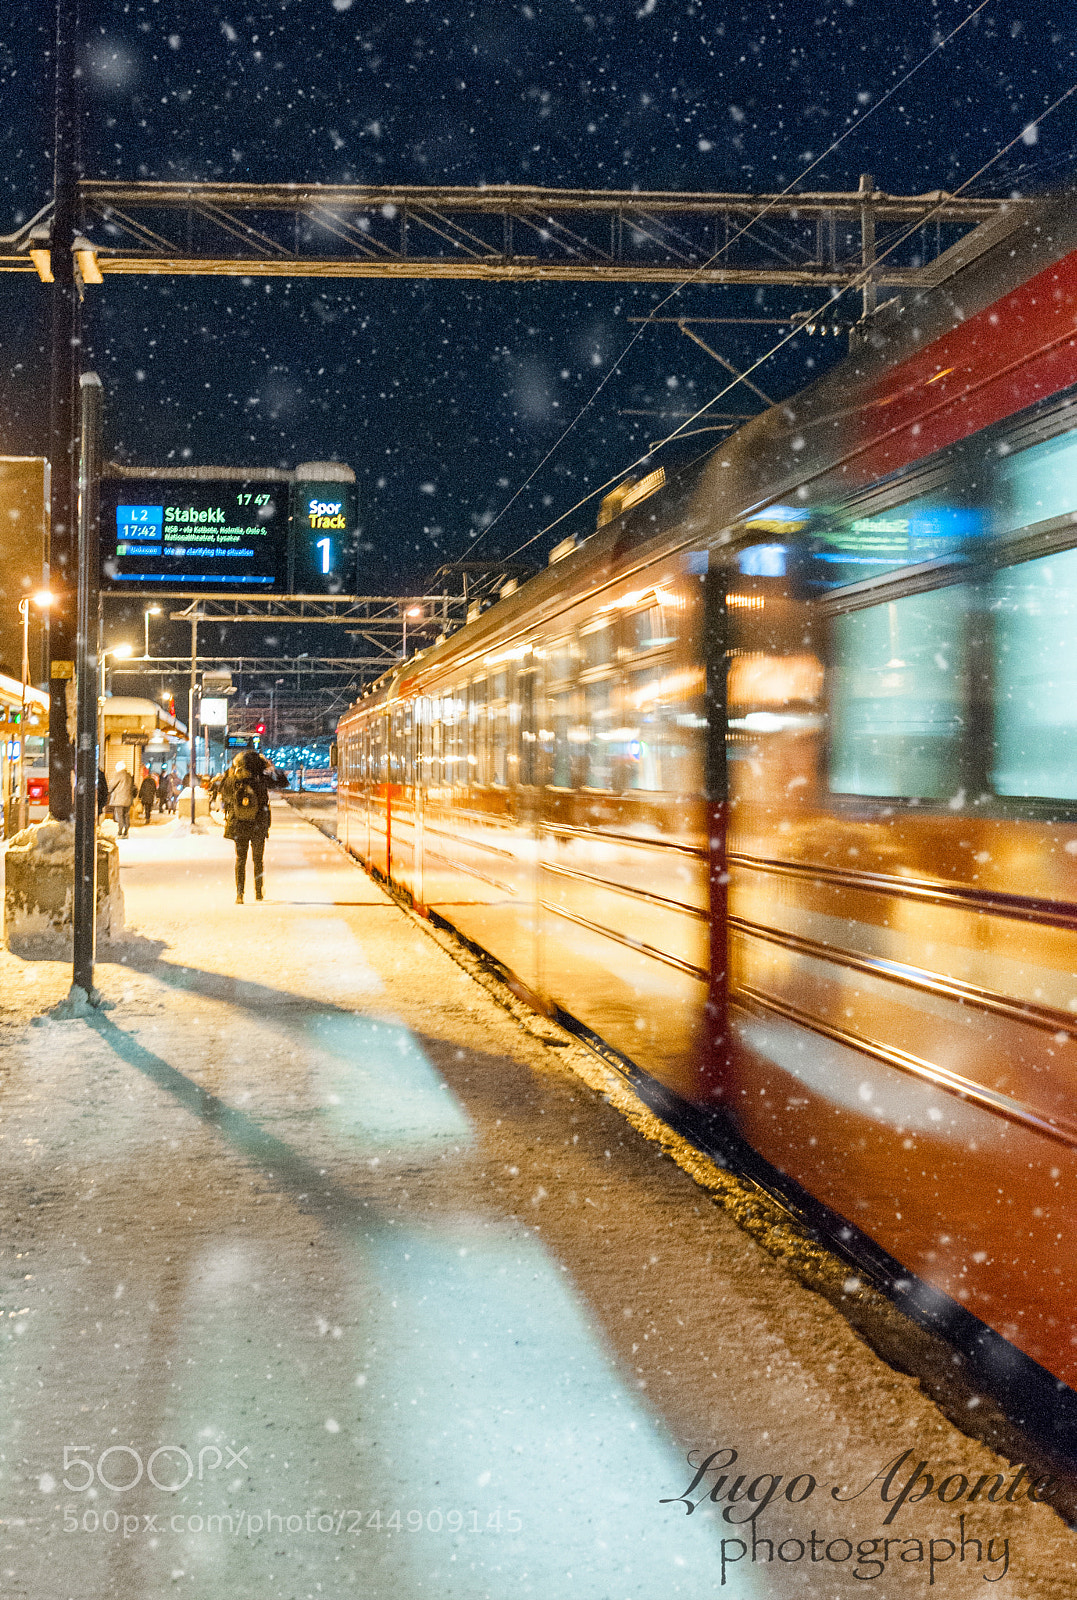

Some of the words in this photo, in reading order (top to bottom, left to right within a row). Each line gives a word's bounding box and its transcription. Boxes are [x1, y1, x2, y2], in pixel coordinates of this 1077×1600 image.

[131, 509, 138, 521] L
[140, 509, 148, 521] 2
[164, 506, 226, 523] Stabekk
[309, 499, 342, 517] Spor
[308, 513, 346, 529] Track
[123, 524, 157, 537] 17:42
[186, 547, 215, 558] clarifying
[215, 548, 227, 557] the
[226, 548, 254, 557] situation
[316, 537, 330, 574] 1
